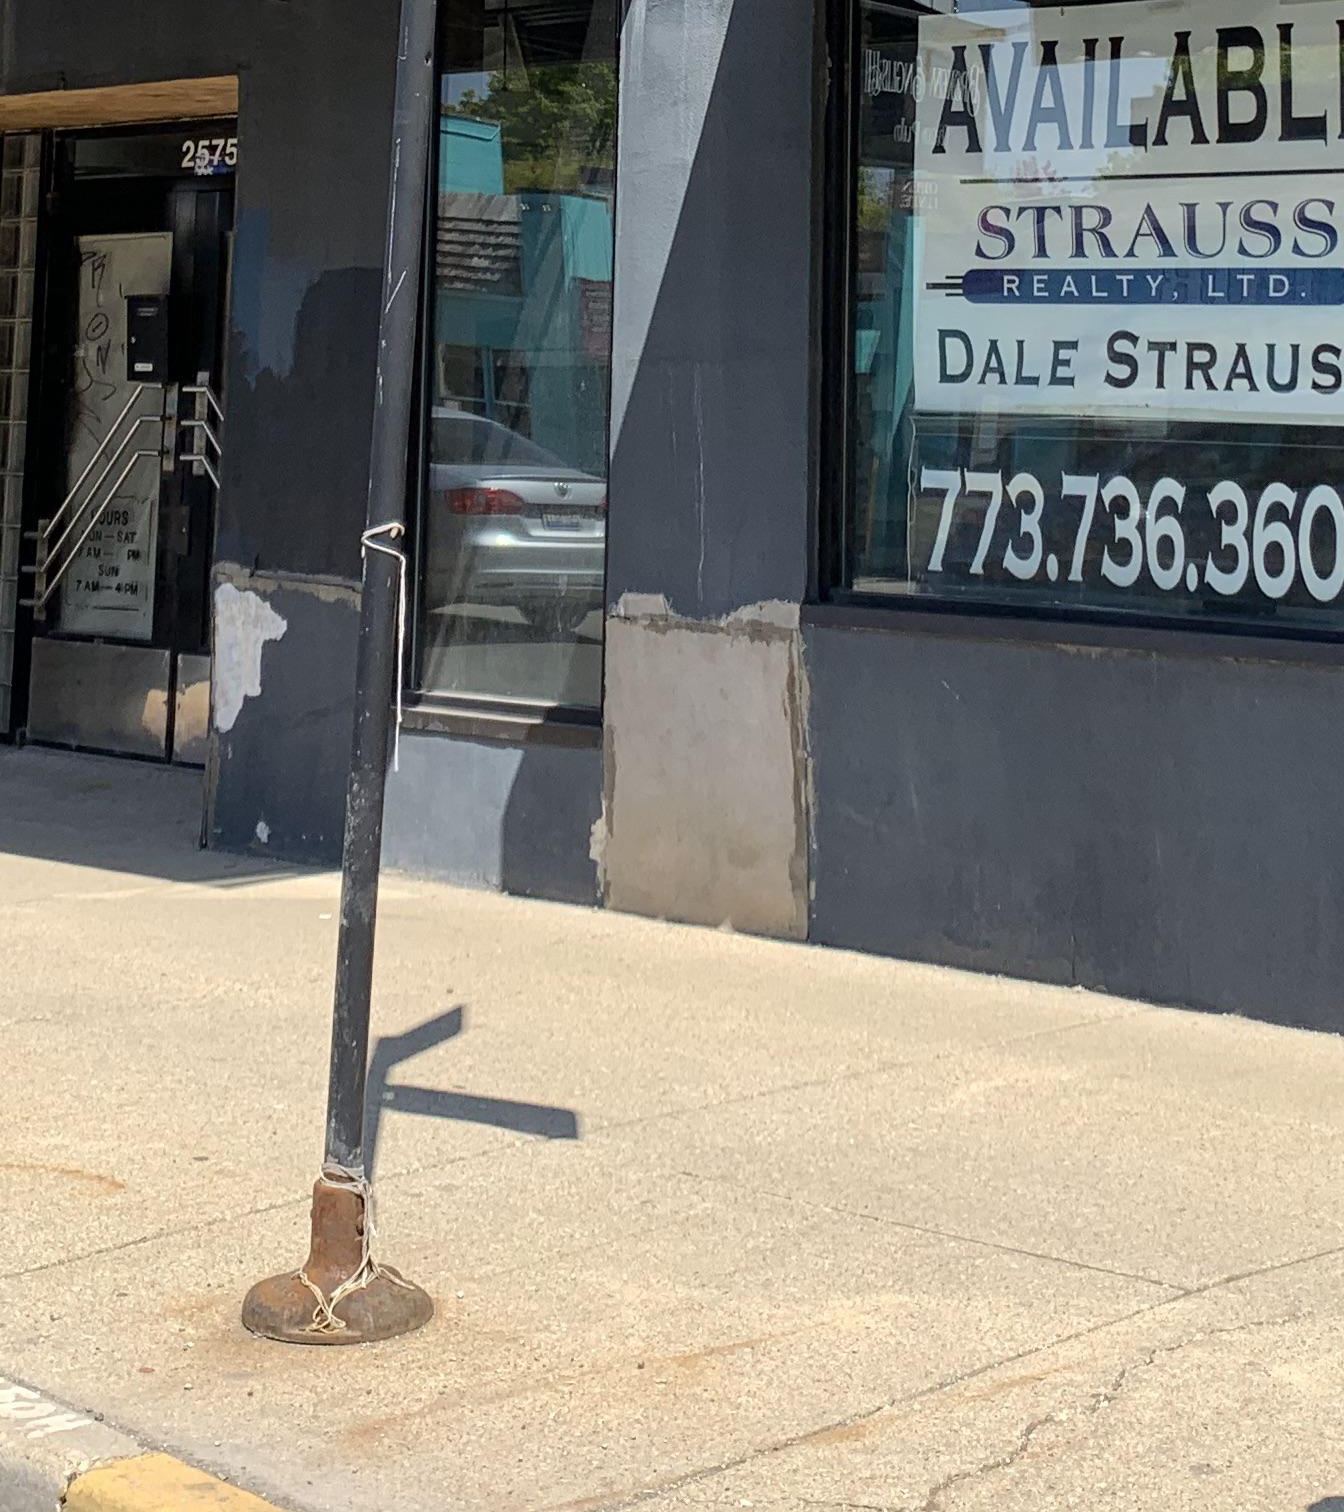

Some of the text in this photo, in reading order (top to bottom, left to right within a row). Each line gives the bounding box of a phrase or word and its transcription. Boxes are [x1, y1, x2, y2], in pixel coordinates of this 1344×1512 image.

[181, 137, 238, 168] 2575
[974, 198, 1339, 260] STRAUSS
[1002, 273, 1308, 300] REALTY, LTD.
[937, 328, 1080, 388] DALE
[117, 530, 137, 544] SAT
[98, 564, 120, 577] SUN
